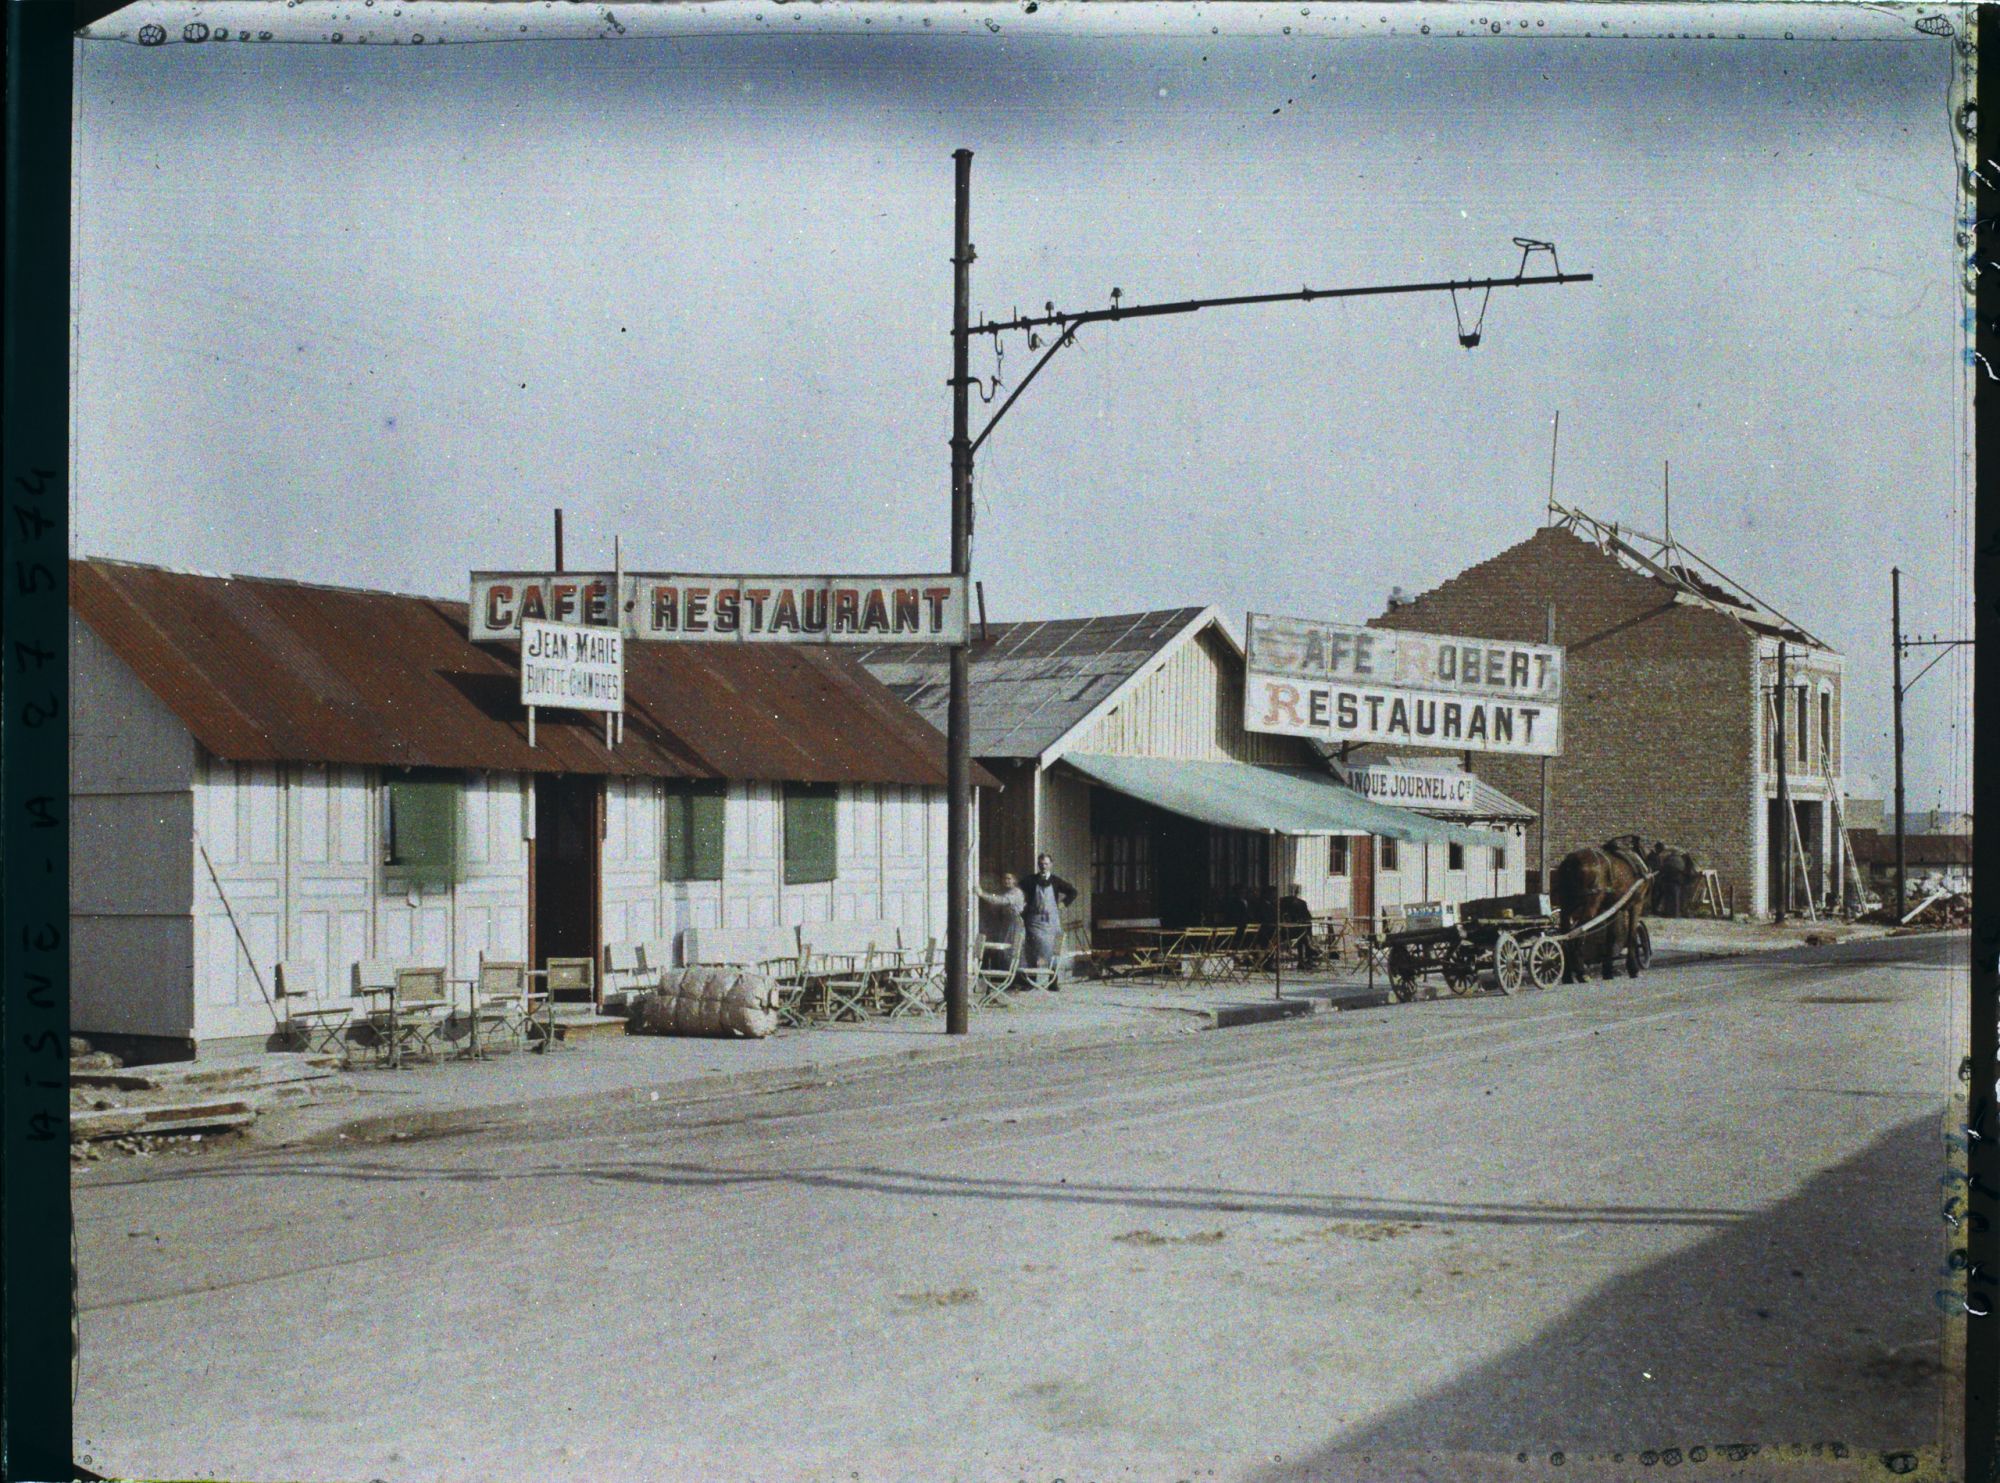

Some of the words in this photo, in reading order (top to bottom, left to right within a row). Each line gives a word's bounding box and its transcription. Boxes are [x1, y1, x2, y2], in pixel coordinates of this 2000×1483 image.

[651, 586, 950, 633] RESTAURANT
[528, 629, 568, 660] JEAN
[575, 632, 617, 664] MARIE
[1262, 683, 1541, 743] RESTAURANT
[1390, 774, 1447, 799] JOURNEL
